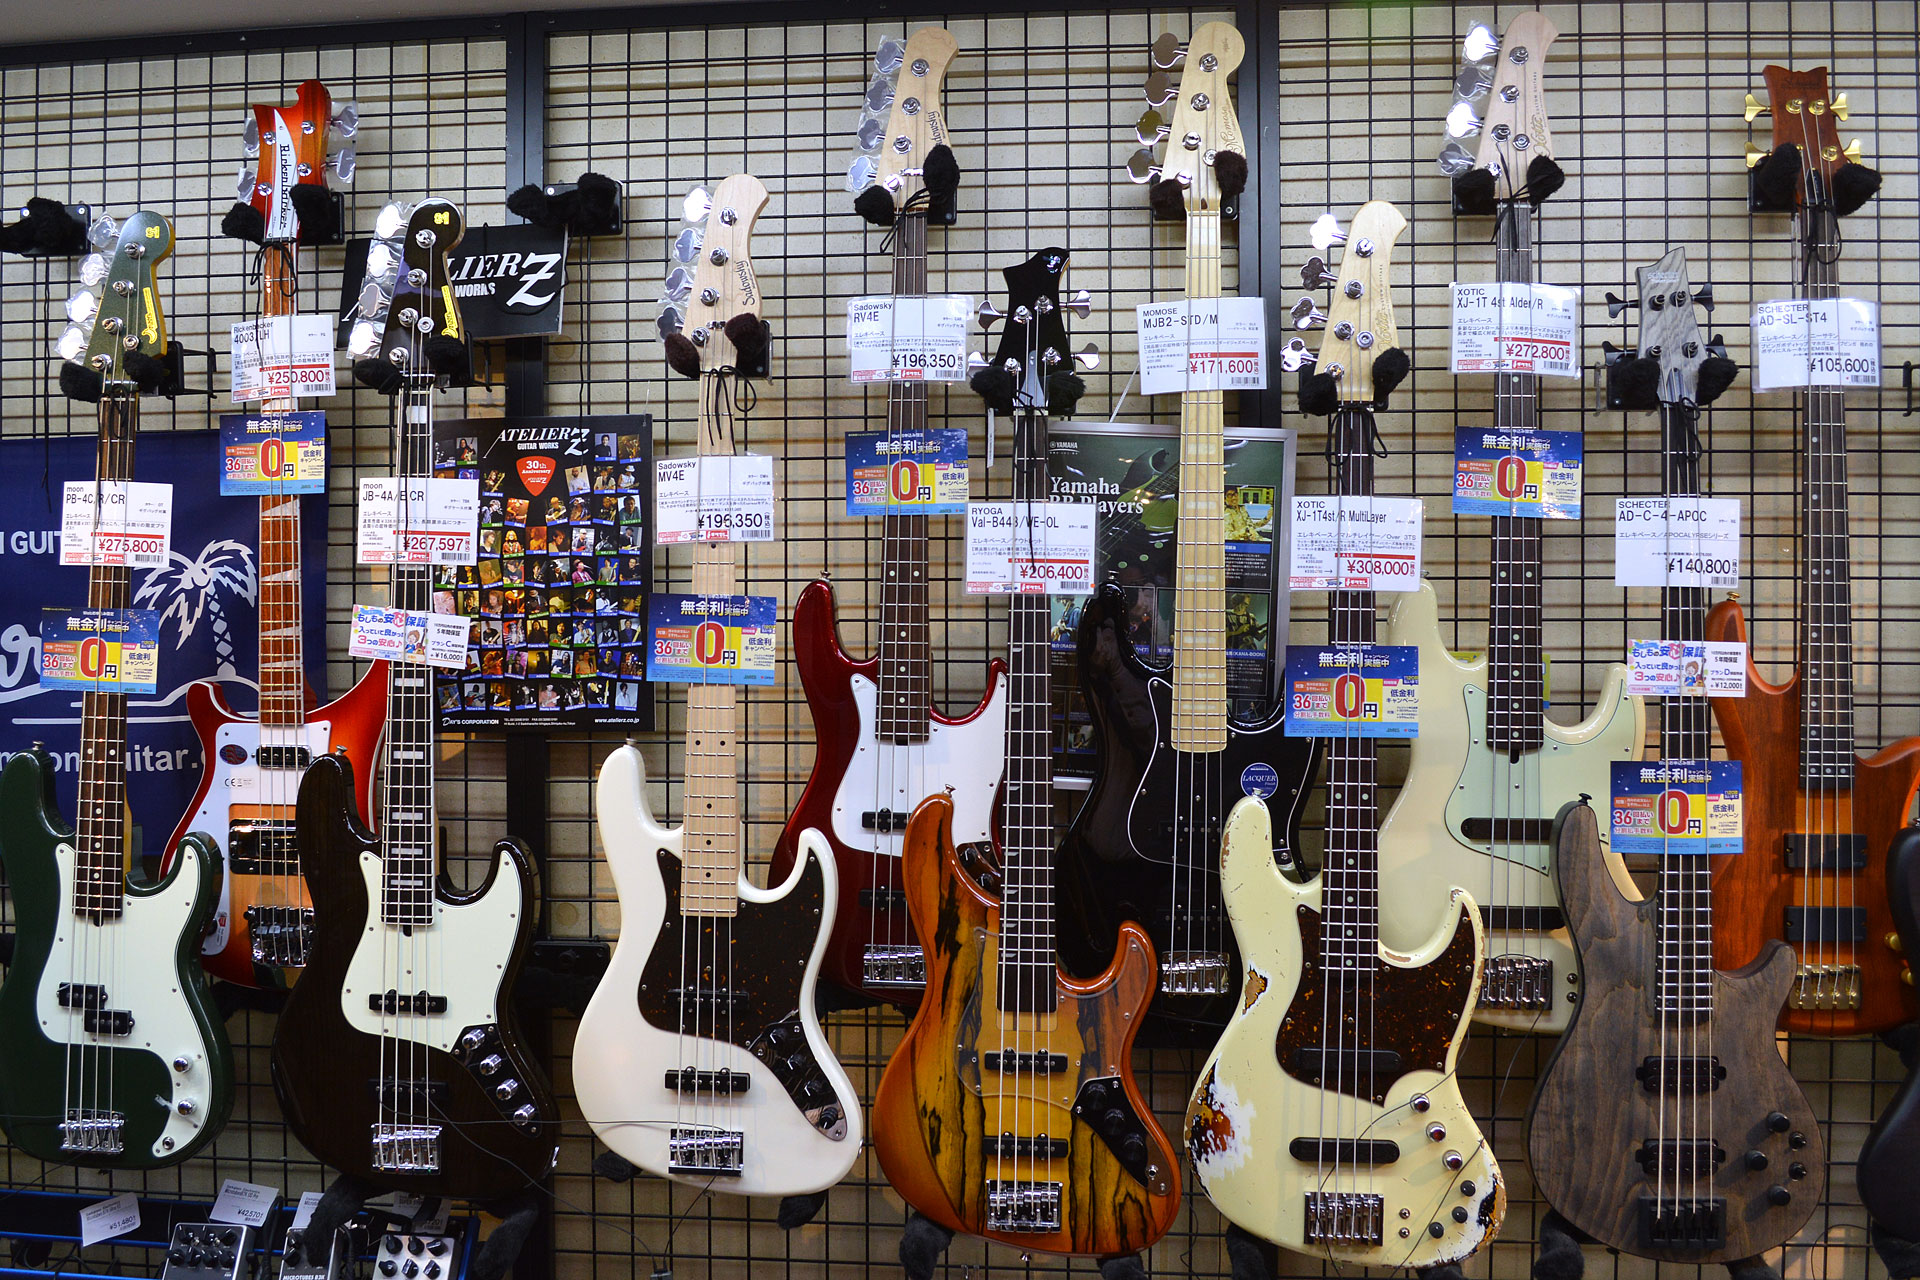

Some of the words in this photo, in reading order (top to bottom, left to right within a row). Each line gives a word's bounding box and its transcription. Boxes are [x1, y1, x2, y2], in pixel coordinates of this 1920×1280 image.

[925, 110, 943, 145] dowsky
[279, 144, 295, 230] Rickenbacker
[446, 253, 522, 280] LIER
[506, 252, 562, 307] Z
[735, 260, 756, 306] Sadowsky
[1457, 288, 1485, 296] XOTIC
[853, 302, 893, 312] Sadowsky
[1457, 297, 1488, 309] XJ-1T
[1491, 297, 1505, 308] 4st
[1509, 297, 1543, 310] Alder/R
[1758, 304, 1809, 314] SCHECTER
[853, 311, 880, 323] RV4E
[1142, 308, 1177, 317] MOMOSE
[1759, 312, 1827, 326] AD-SL-ST4
[1143, 314, 1218, 329] MJB2-STD/M
[1505, 343, 1565, 360] ¥272,800
[892, 354, 956, 369] ¥196,350
[1190, 359, 1253, 374] ¥171,600
[1807, 358, 1869, 373] ¥105,600
[268, 370, 324, 384] ¥250,800
[246, 420, 281, 433] 無金利
[483, 427, 571, 459] ATELIER
[564, 427, 590, 456] Z
[517, 442, 537, 450] GUITAR
[539, 442, 559, 450] WORKS
[876, 440, 917, 455] 無金利
[1482, 434, 1526, 451] 無金利
[226, 458, 241, 471] 36
[526, 460, 547, 469] 30th
[658, 461, 696, 470] Sadowsky
[658, 470, 684, 482] MV4E
[1456, 473, 1474, 488] 36
[853, 481, 870, 495] 36
[1050, 477, 1120, 495] Yamaha
[363, 490, 425, 502] JB-4A/ECR
[971, 507, 1003, 515] RYOGA
[1297, 501, 1326, 509] XOTIC
[1618, 501, 1670, 509] SCHECTER
[698, 513, 763, 529] ¥196,350
[1349, 510, 1387, 524] MultiLayer
[1618, 510, 1707, 522] AD-C-4-APOC
[99, 538, 158, 553] ¥275,800
[403, 537, 464, 552] ¥267,597
[1020, 564, 1083, 580] ¥206,400
[1347, 560, 1409, 576] ¥308,000
[1665, 558, 1730, 574] ¥140,800
[680, 600, 724, 616] 無金利
[67, 617, 107, 632] 無金利
[655, 640, 672, 654] 36
[43, 655, 59, 668] 36
[1318, 652, 1364, 668] 無金利
[1293, 694, 1311, 710] 36
[1640, 768, 1687, 783] 無金利
[1613, 810, 1632, 825] 36
